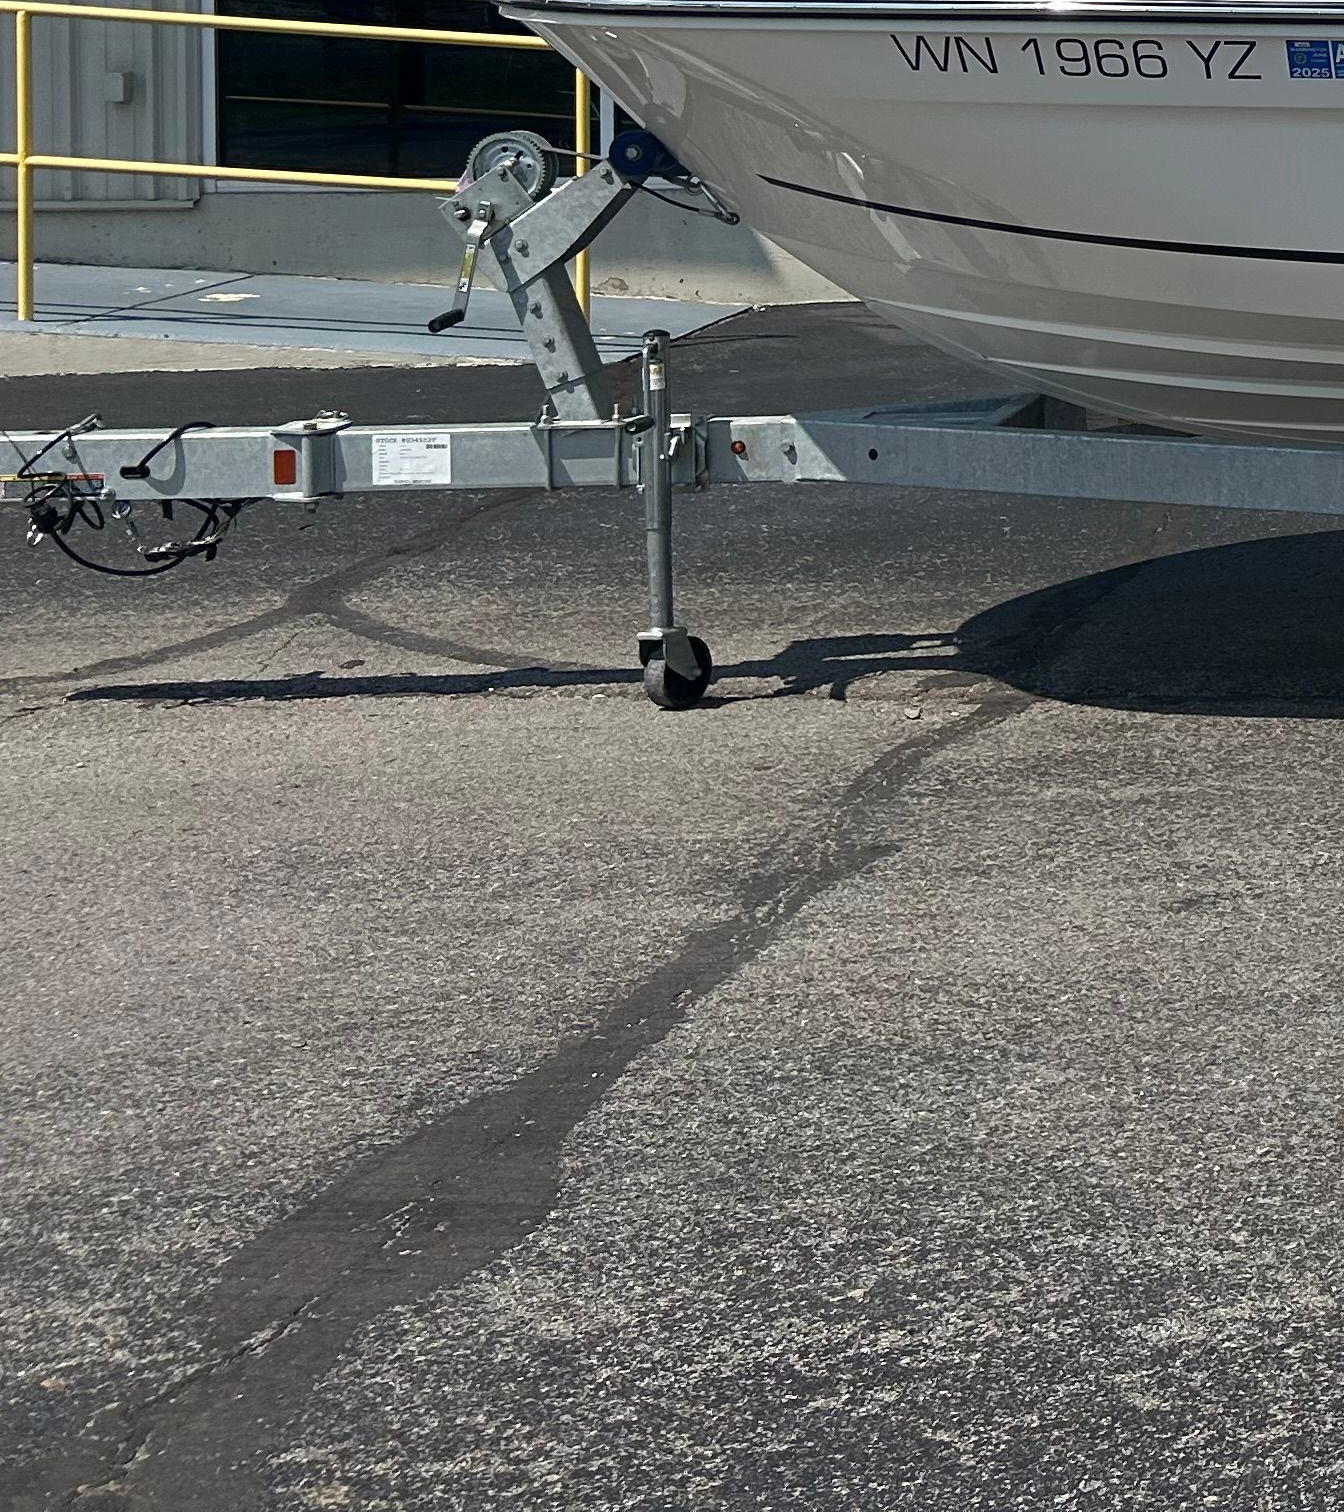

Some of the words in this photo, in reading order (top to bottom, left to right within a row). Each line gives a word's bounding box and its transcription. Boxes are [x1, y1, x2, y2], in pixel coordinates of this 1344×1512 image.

[890, 33, 999, 75] WN
[1020, 37, 1169, 80] 1966
[1185, 39, 1263, 80] YZ
[1292, 67, 1331, 77] 2025
